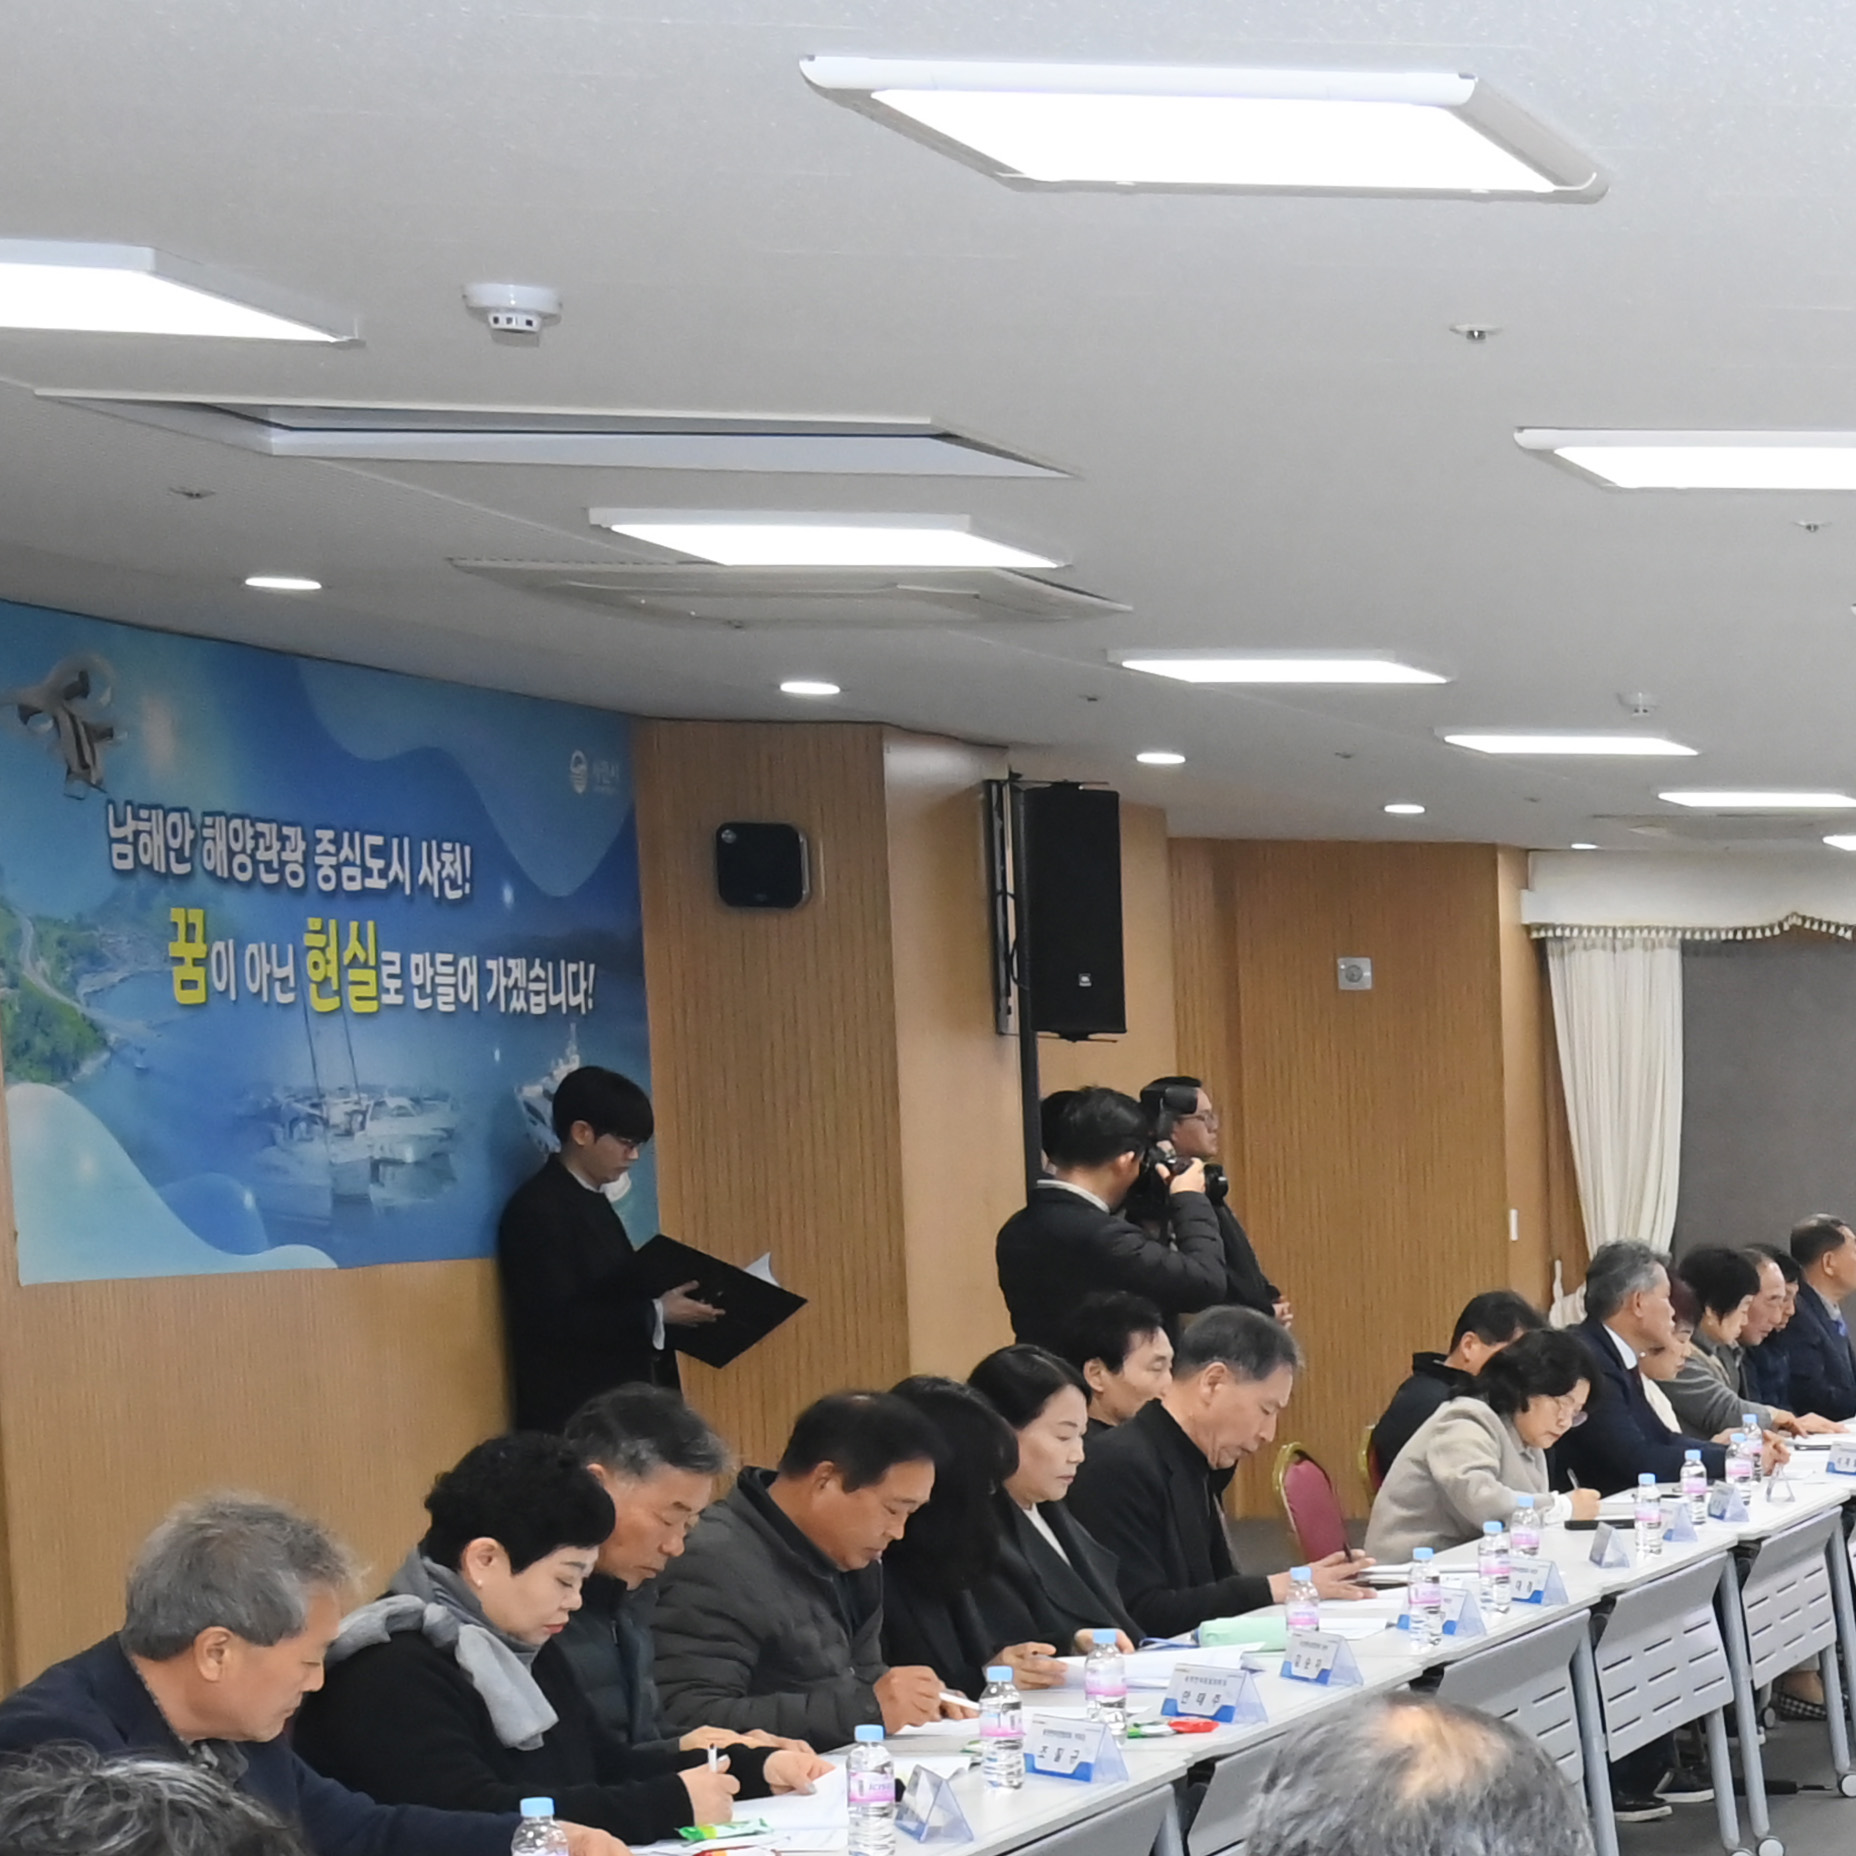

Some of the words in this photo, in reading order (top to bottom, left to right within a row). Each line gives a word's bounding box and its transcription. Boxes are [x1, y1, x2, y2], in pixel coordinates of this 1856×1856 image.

[108, 803, 194, 874] 남해안
[203, 812, 305, 888] 해양관광
[315, 831, 411, 896] 중심도시
[418, 840, 471, 900] 사천!
[168, 907, 236, 1005] 꿈이
[245, 942, 296, 1004] 아닌
[304, 917, 405, 1014] 현실로
[410, 952, 479, 1012] 만들어
[486, 956, 595, 1015] 가겠습니다!
